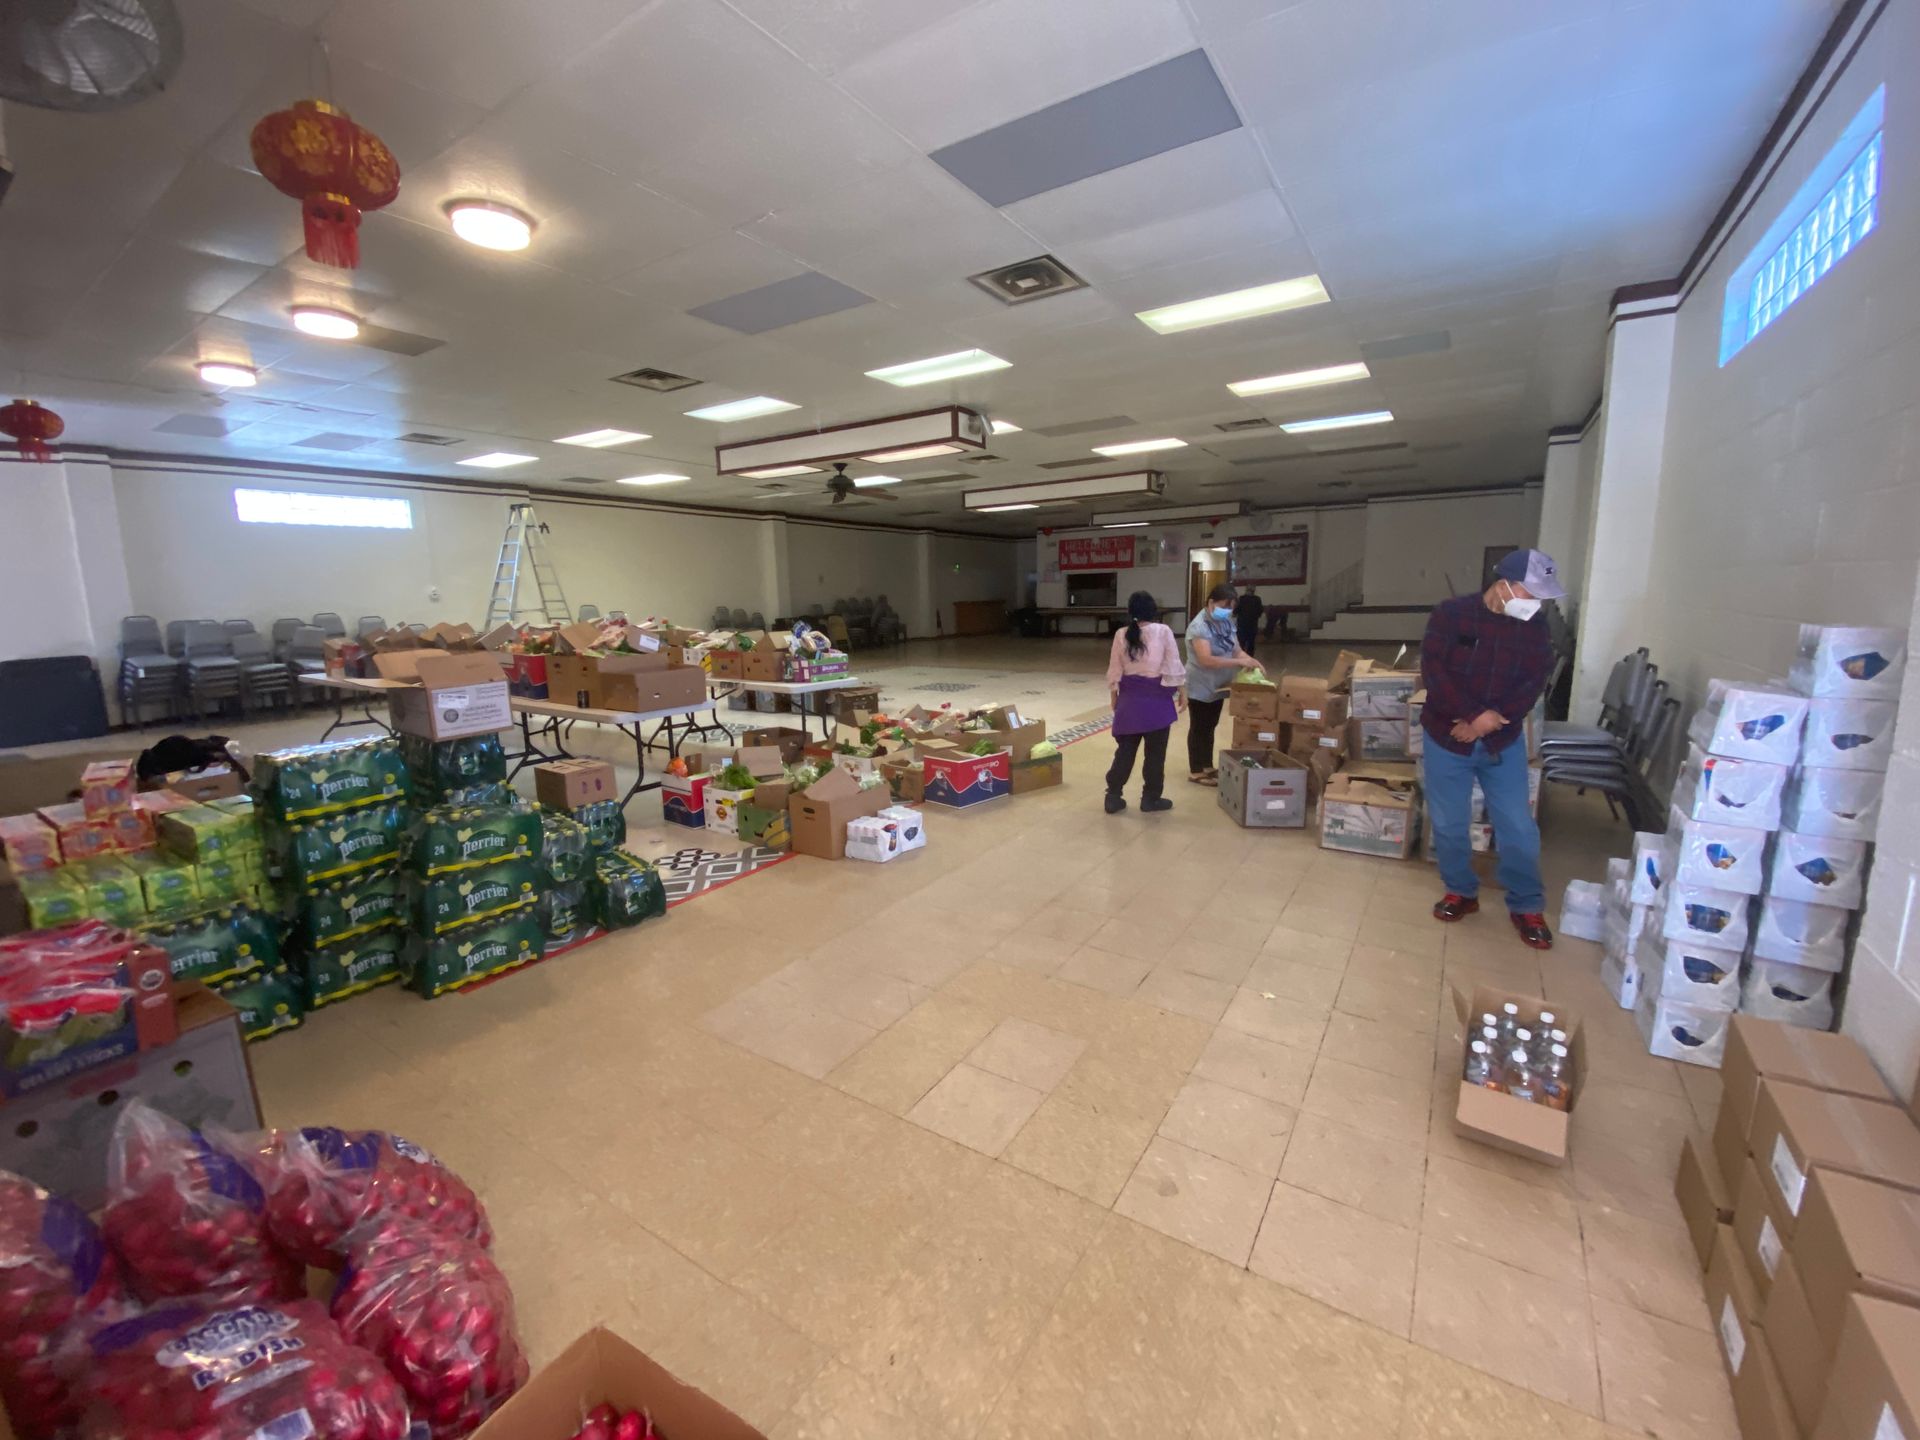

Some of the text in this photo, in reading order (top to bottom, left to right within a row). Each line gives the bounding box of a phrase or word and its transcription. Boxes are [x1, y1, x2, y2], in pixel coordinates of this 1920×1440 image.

[320, 774, 369, 803] perrier
[308, 850, 321, 863] 24
[339, 832, 385, 863] perrier
[434, 845, 445, 856] 24
[462, 834, 506, 861] perrier
[348, 896, 394, 927] perrier
[438, 902, 449, 914] 24
[465, 884, 509, 914] perrier
[347, 951, 395, 984] perrier
[438, 963, 449, 975] 24
[465, 943, 508, 974] perrier
[195, 1337, 303, 1387] RDISH
